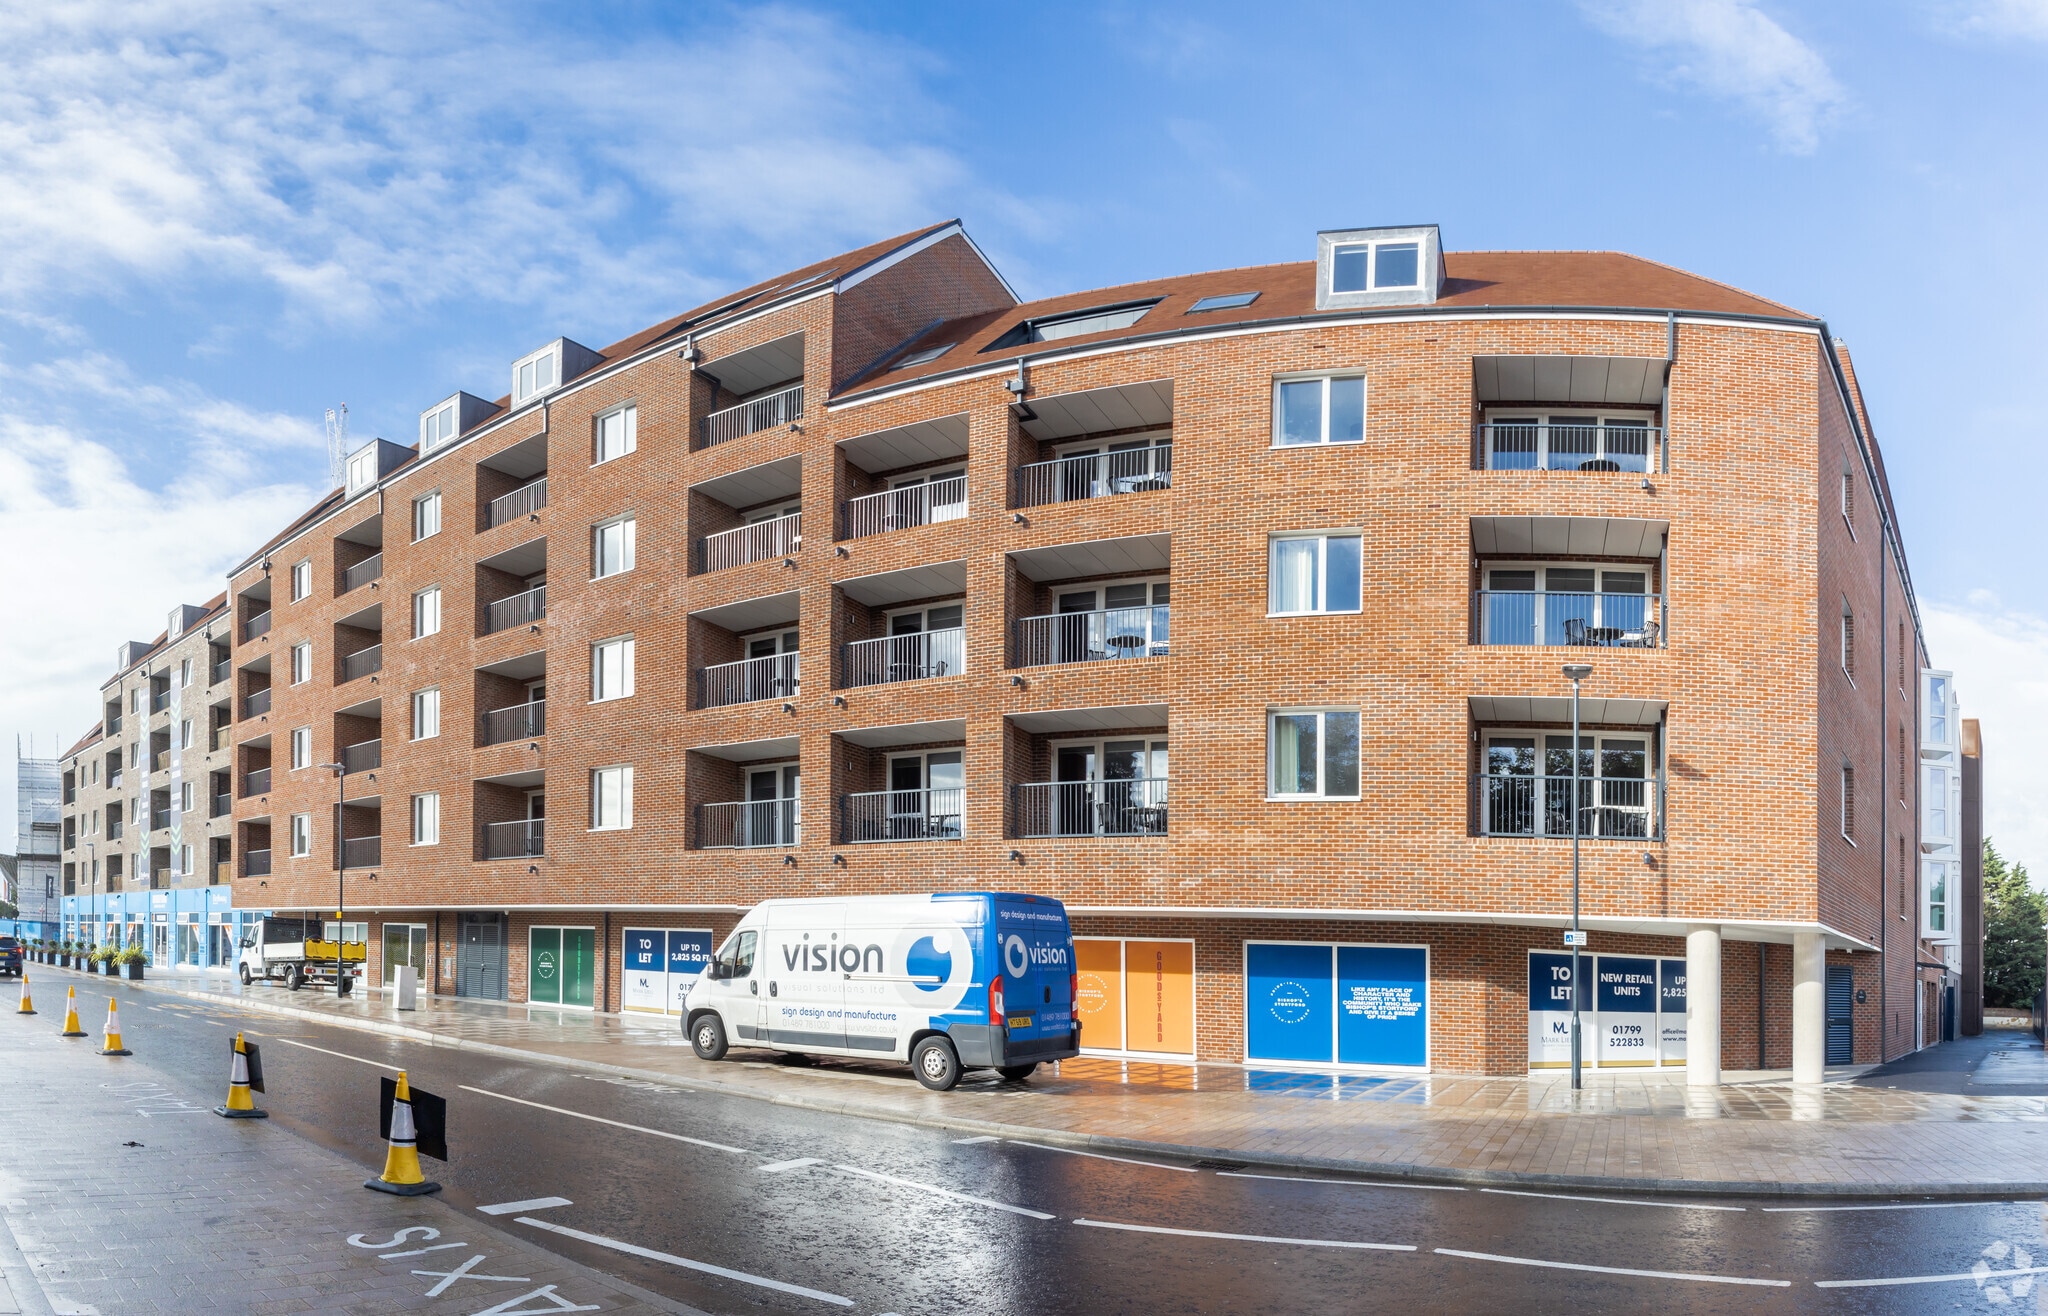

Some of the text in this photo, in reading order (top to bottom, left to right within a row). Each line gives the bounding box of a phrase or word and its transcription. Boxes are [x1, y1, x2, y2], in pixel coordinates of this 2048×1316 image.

[1011, 911, 1026, 920] design
[639, 938, 652, 950] TO
[672, 953, 690, 962] 2,825
[691, 954, 701, 962] SQ
[782, 932, 883, 973] vision
[1029, 941, 1066, 964] vision
[638, 953, 652, 963] LET
[1551, 966, 1570, 980] TO
[1600, 973, 1654, 984] NEW RETAIL
[1674, 976, 1686, 984] UP
[1550, 986, 1572, 1000] LET
[1614, 986, 1640, 996] UNITS
[1662, 988, 1686, 998] 2,825
[782, 1006, 897, 1021] sign design and manufacture
[1612, 1025, 1642, 1034] 01799
[1610, 1038, 1644, 1047] 522833
